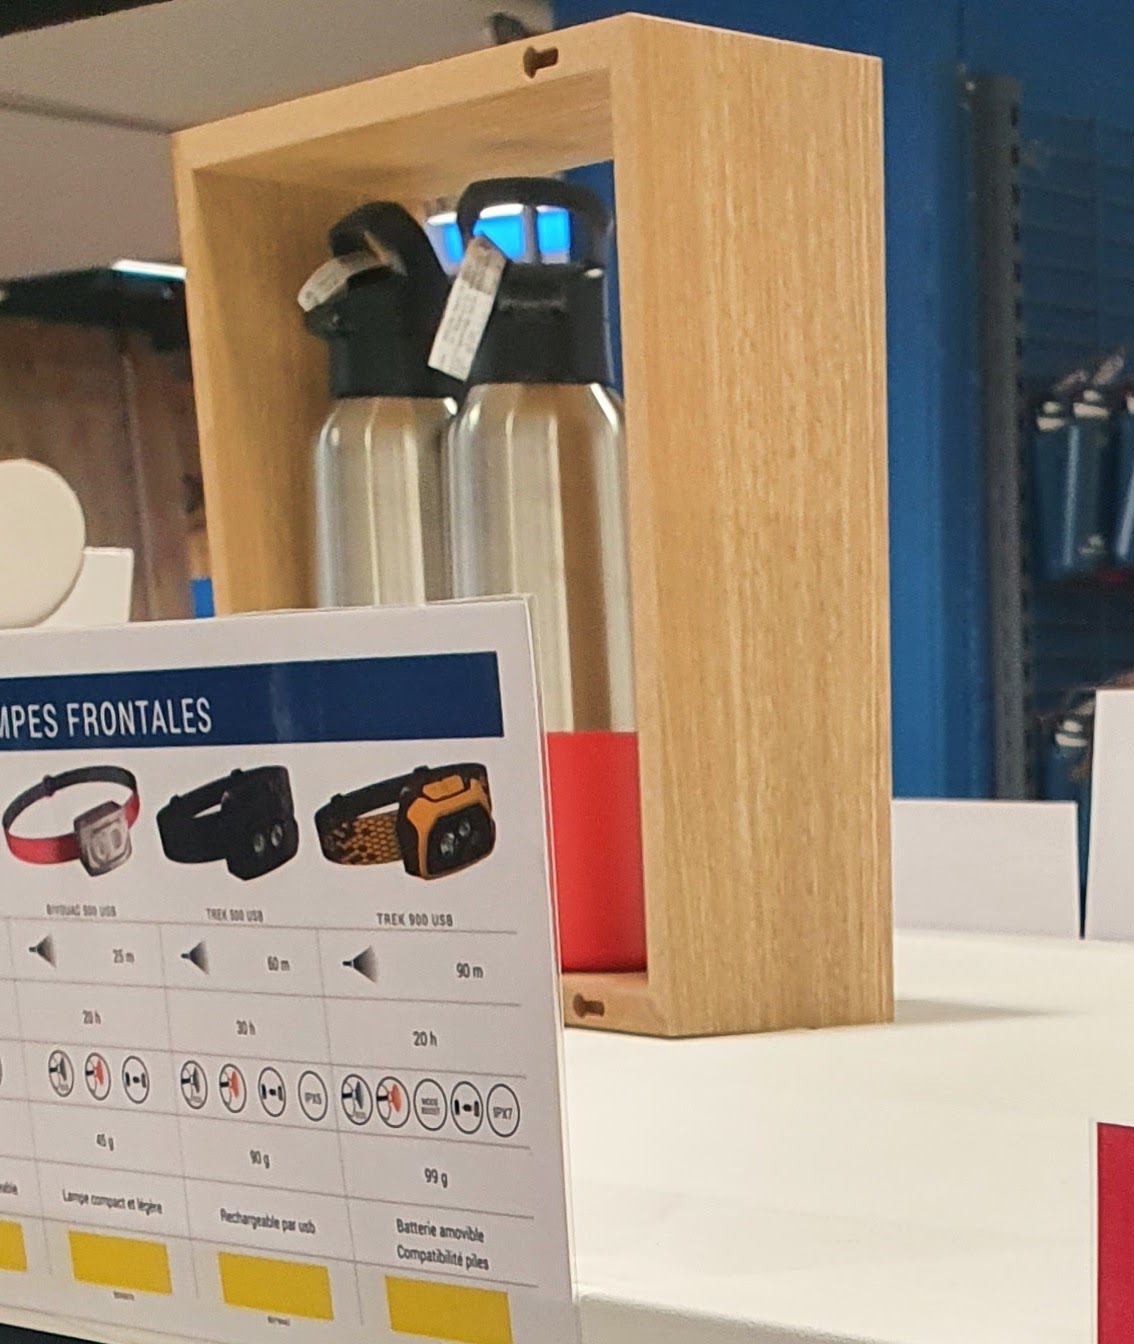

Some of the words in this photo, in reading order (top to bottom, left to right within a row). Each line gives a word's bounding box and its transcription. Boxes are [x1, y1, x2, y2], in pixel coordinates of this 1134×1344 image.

[66, 697, 212, 737] FRONTALES
[205, 907, 228, 921] TREK
[376, 913, 405, 926] TREK
[409, 914, 428, 927] 900
[432, 914, 453, 927] USB
[456, 962, 470, 979] 90
[472, 966, 484, 979] m
[413, 1031, 428, 1047] 20
[429, 1031, 438, 1046] h
[424, 1167, 438, 1185] 99
[441, 1171, 448, 1189] g
[220, 1208, 281, 1232] Rechargeable
[282, 1219, 297, 1233] par
[298, 1219, 316, 1235] usb
[396, 1218, 437, 1238] Batterie
[440, 1226, 485, 1244] amovible
[396, 1245, 463, 1266] Compatibilité
[465, 1254, 490, 1272] piles
